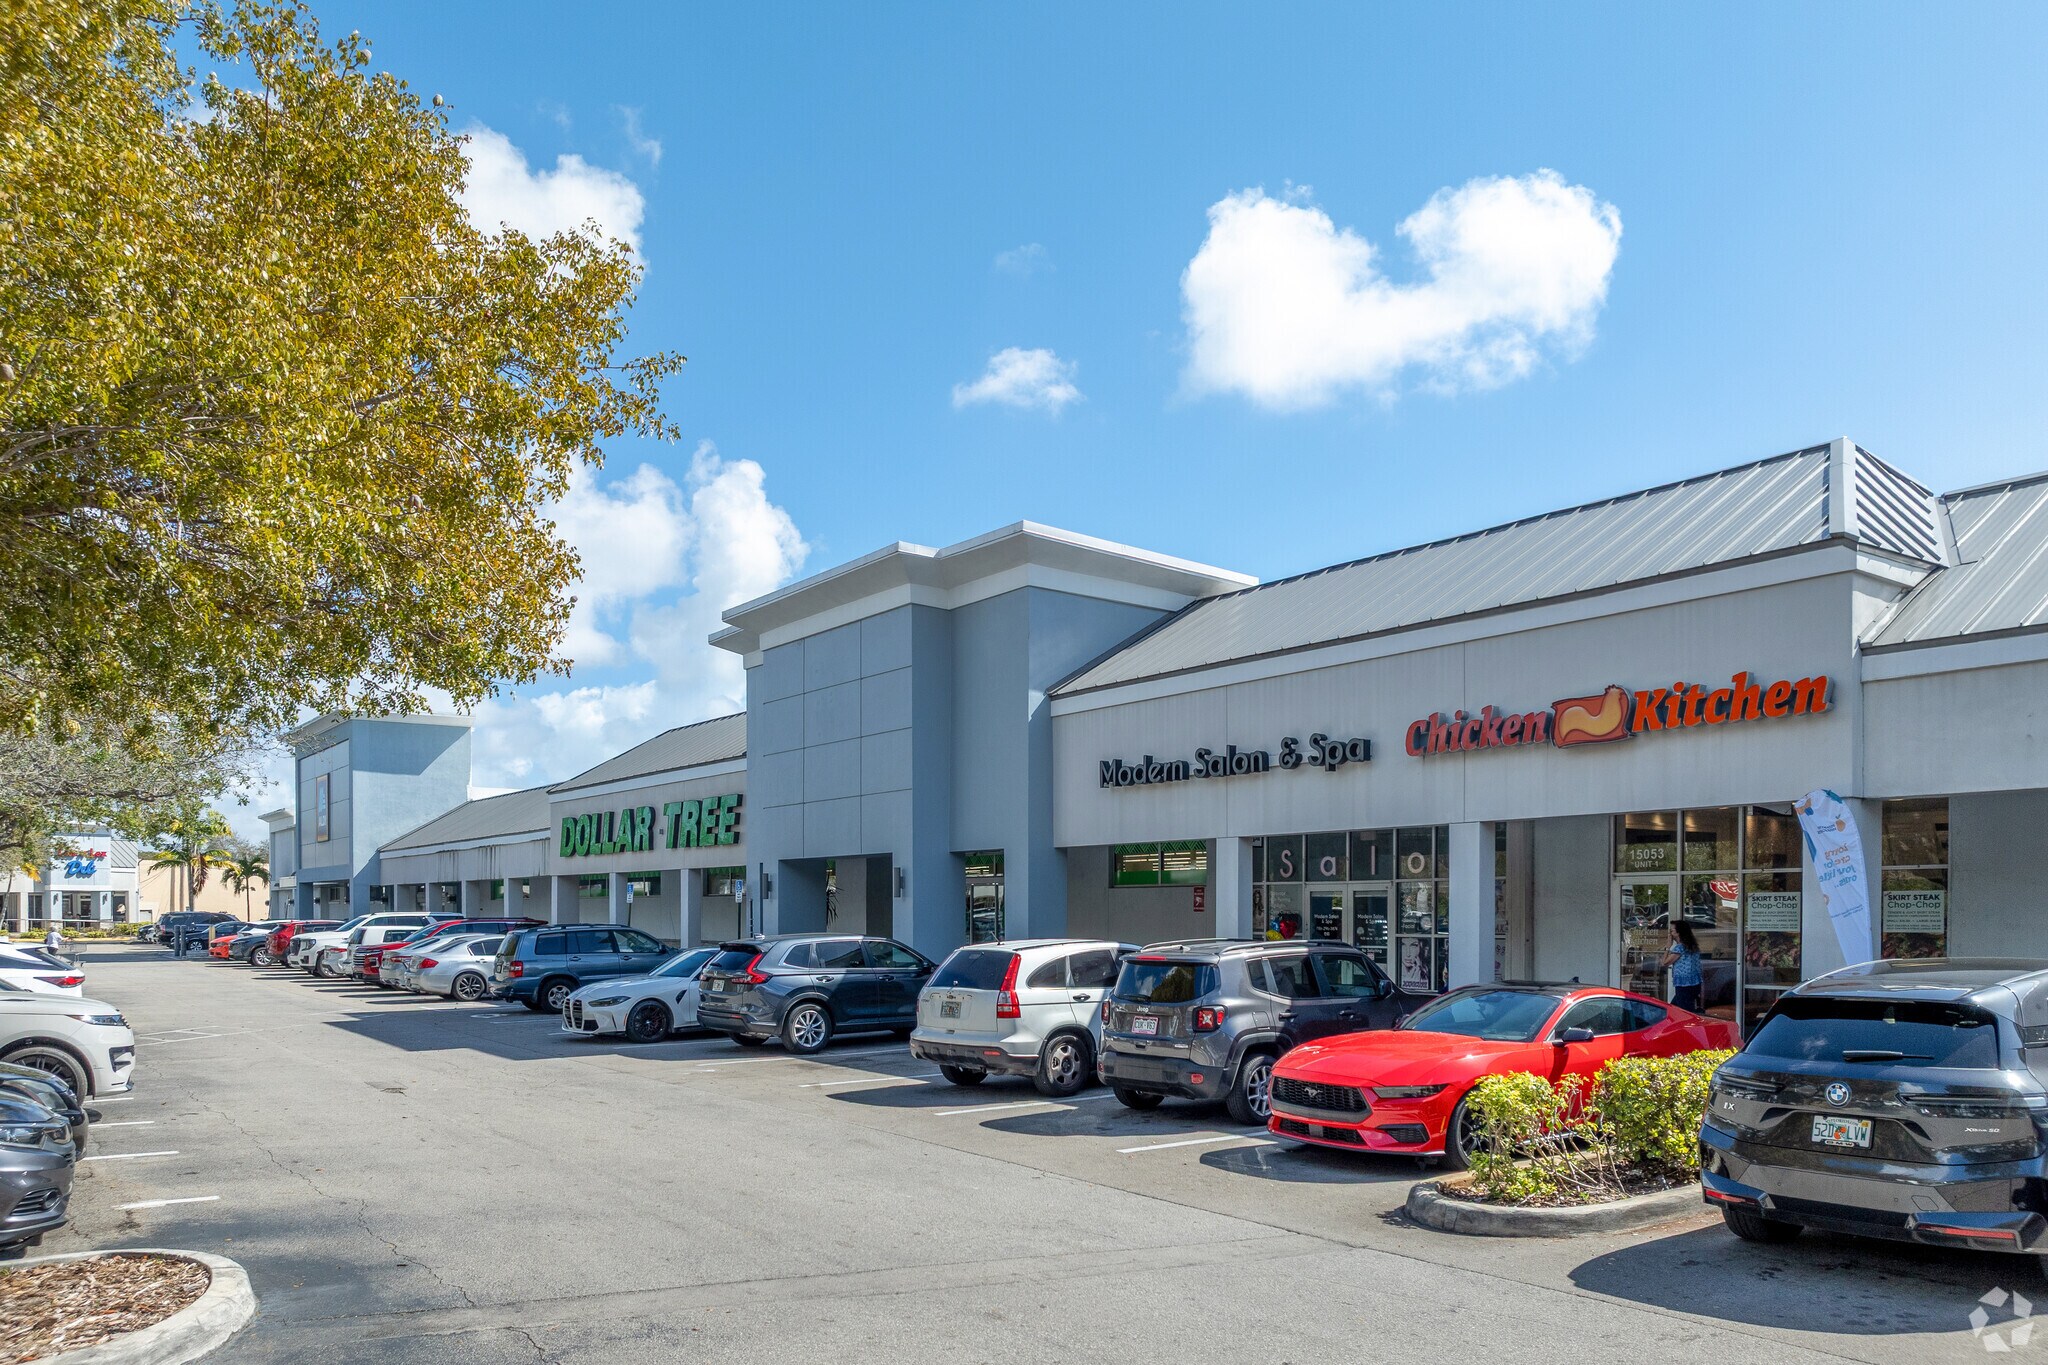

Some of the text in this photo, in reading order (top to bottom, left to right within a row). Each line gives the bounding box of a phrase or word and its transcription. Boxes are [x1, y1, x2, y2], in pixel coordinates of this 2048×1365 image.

[1405, 671, 1834, 758] Chicken Kitchen
[1100, 733, 1372, 788] Modern Salon & Spa
[560, 794, 743, 858] DOLLAR TREE
[1630, 848, 1665, 860] 15053
[1634, 860, 1652, 868] UNIT
[1751, 901, 1798, 909] Chop-Chop
[1887, 901, 1941, 909] Chop-Chop
[1136, 1005, 1149, 1013] Jeep
